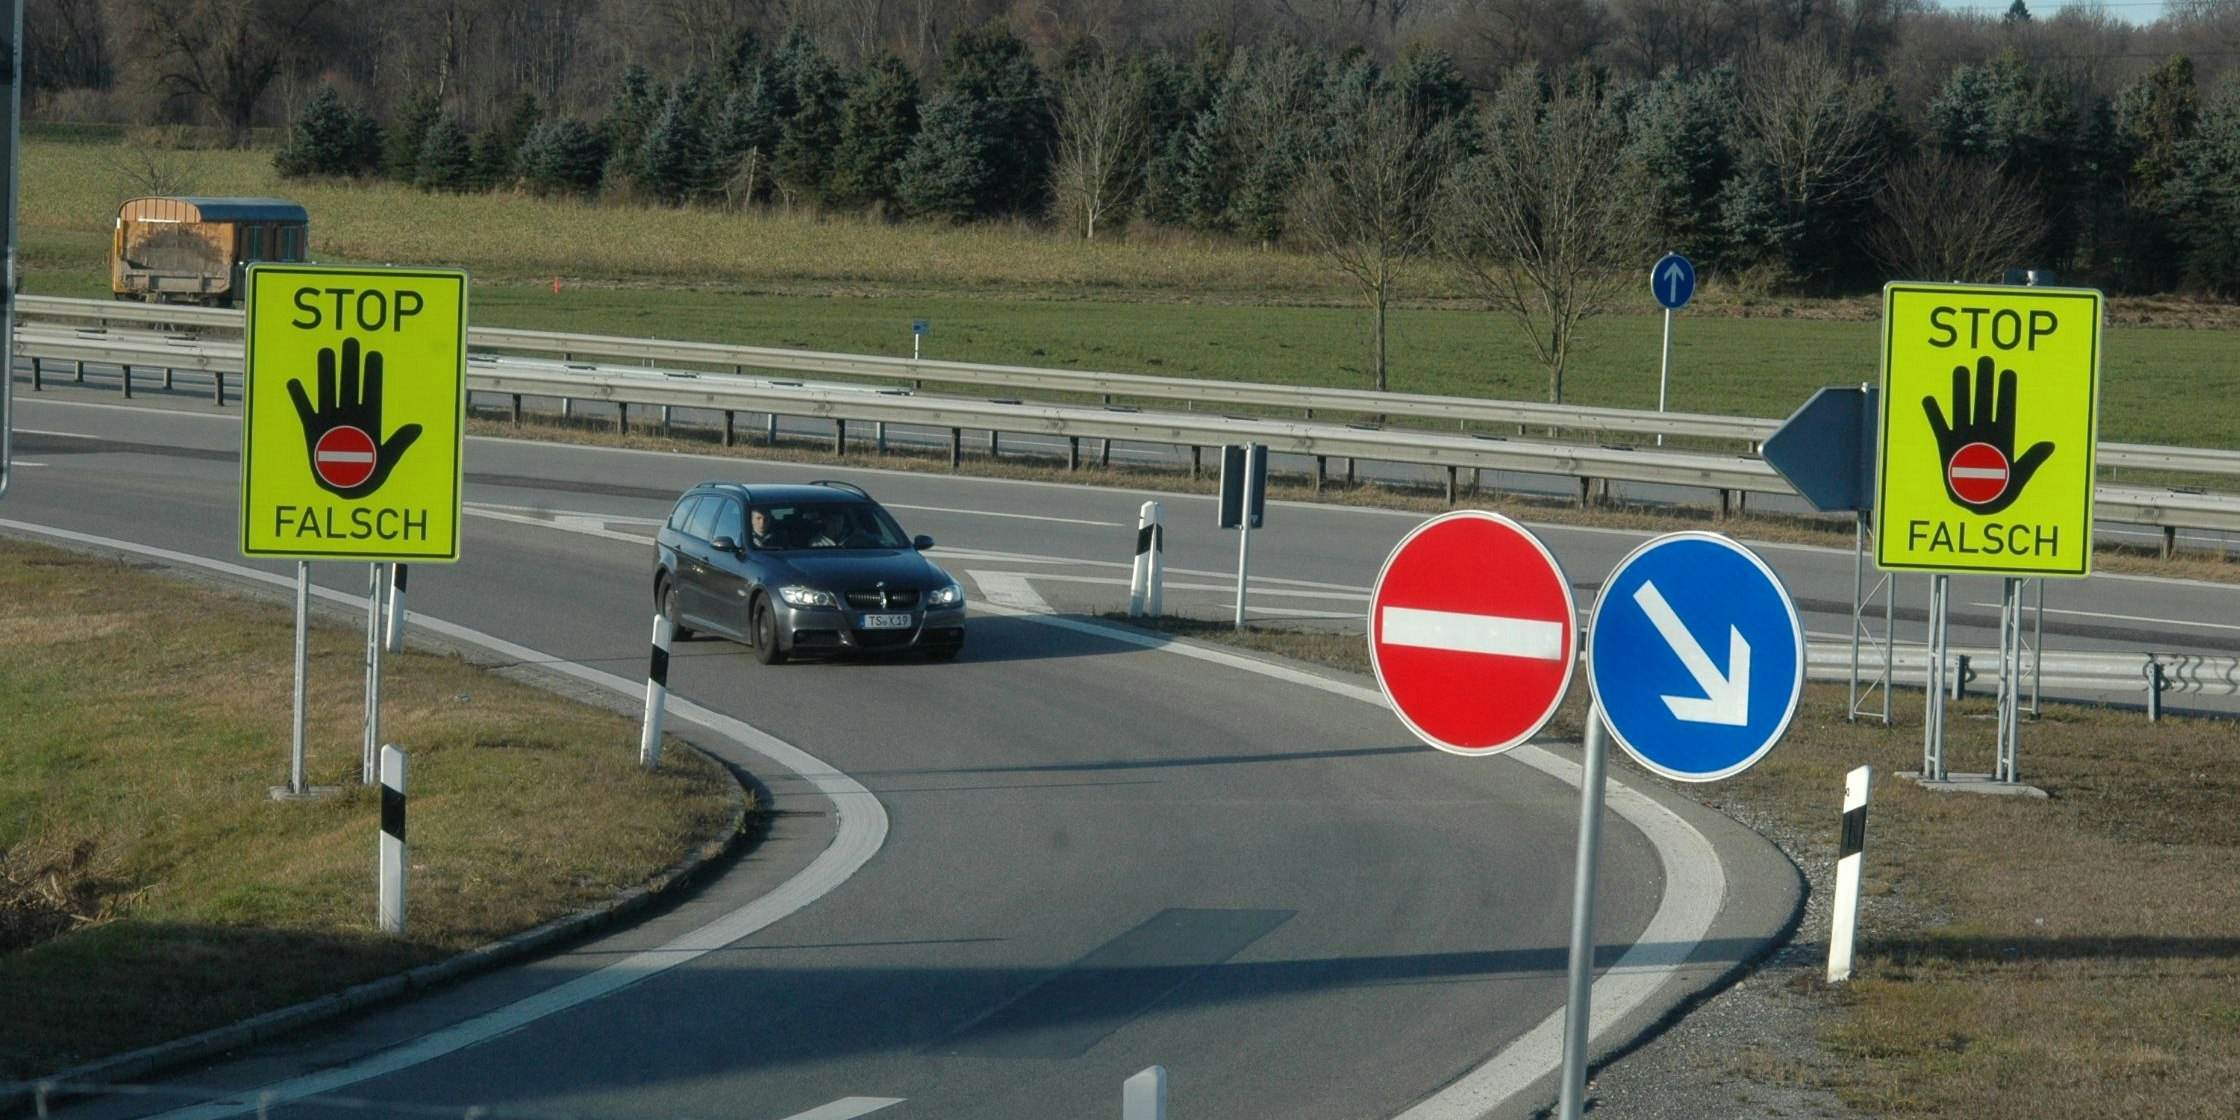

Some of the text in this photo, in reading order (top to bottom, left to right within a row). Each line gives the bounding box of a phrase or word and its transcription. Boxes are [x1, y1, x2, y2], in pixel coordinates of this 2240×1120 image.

[291, 286, 424, 333] STOP
[1927, 306, 2058, 351] STOP
[275, 505, 427, 541] FALSCH
[1908, 520, 2059, 557] FALSCH
